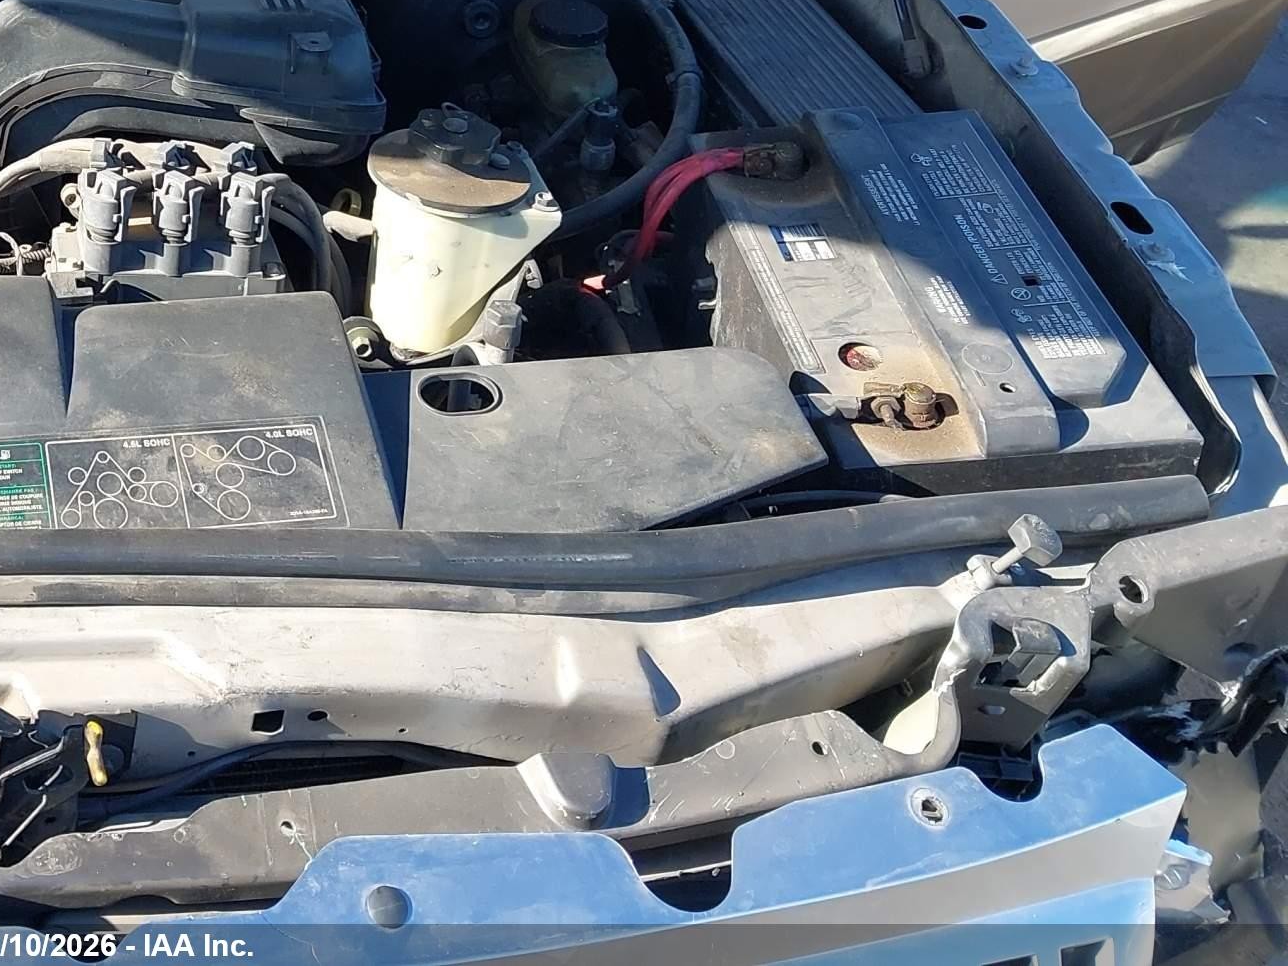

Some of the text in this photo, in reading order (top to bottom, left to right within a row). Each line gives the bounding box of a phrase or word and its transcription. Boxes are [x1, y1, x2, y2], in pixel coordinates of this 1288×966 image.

[954, 214, 999, 274] DANGER/POISON
[266, 428, 312, 438] 4.0L SOHC
[144, 438, 170, 447] SOHC
